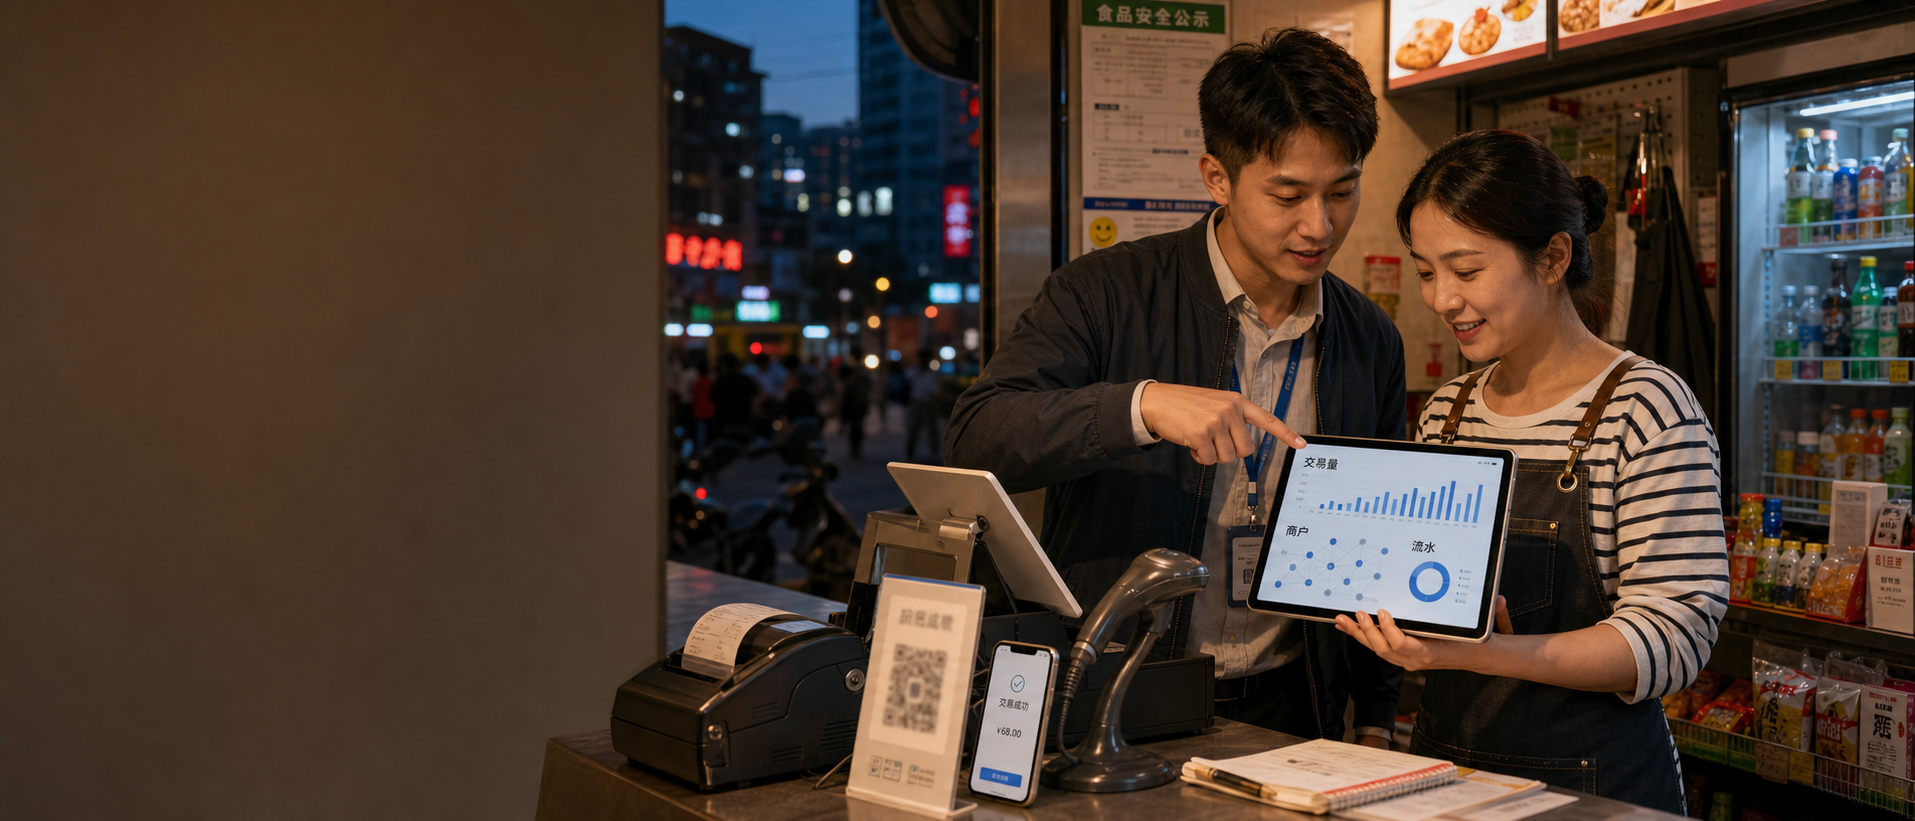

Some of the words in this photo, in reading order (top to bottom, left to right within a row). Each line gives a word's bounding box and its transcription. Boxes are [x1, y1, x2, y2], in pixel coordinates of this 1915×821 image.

[1096, 3, 1210, 29] 食品安全公示
[1303, 456, 1338, 471] 交易量
[1285, 525, 1309, 537] 商户
[1411, 540, 1436, 553] 流水
[996, 726, 1022, 738] ¥68.00
